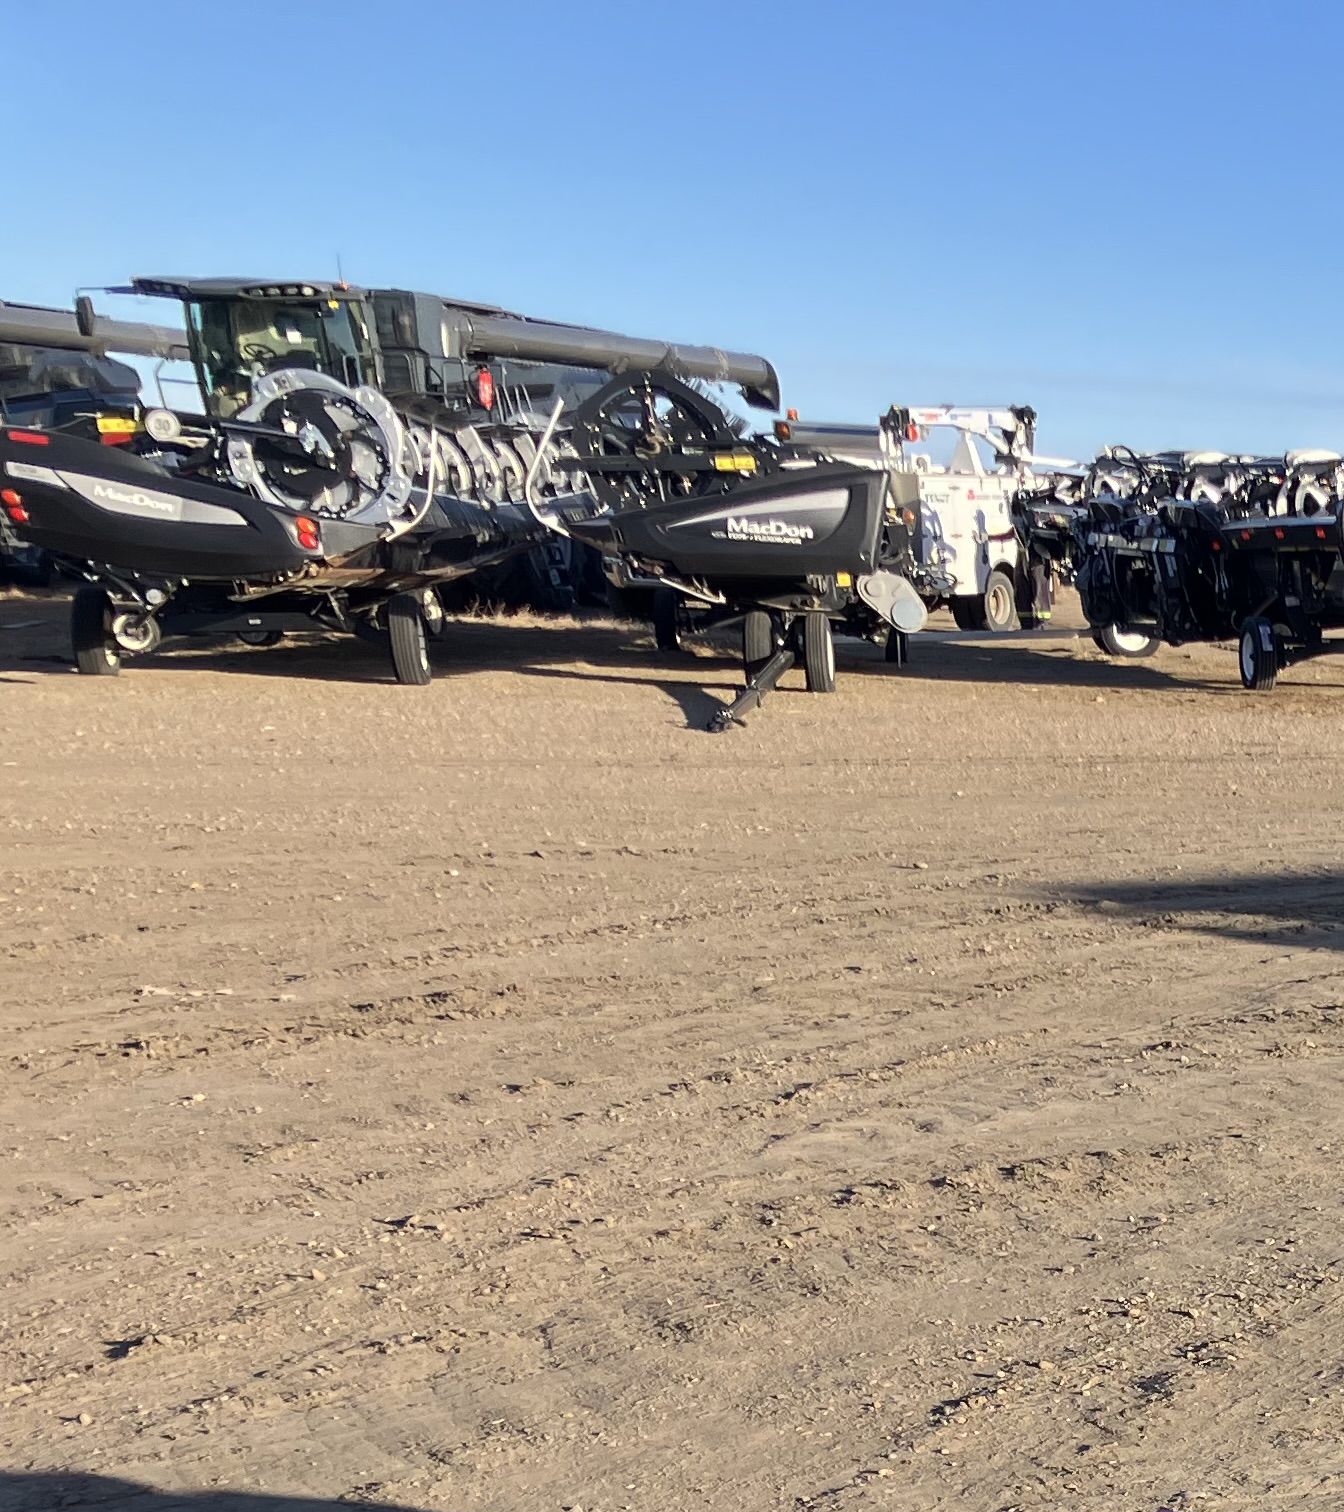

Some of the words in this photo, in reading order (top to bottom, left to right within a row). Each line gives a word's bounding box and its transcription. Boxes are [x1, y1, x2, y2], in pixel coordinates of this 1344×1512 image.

[154, 418, 171, 432] 30
[93, 485, 174, 512] MacDon
[726, 516, 814, 540] MacDon
